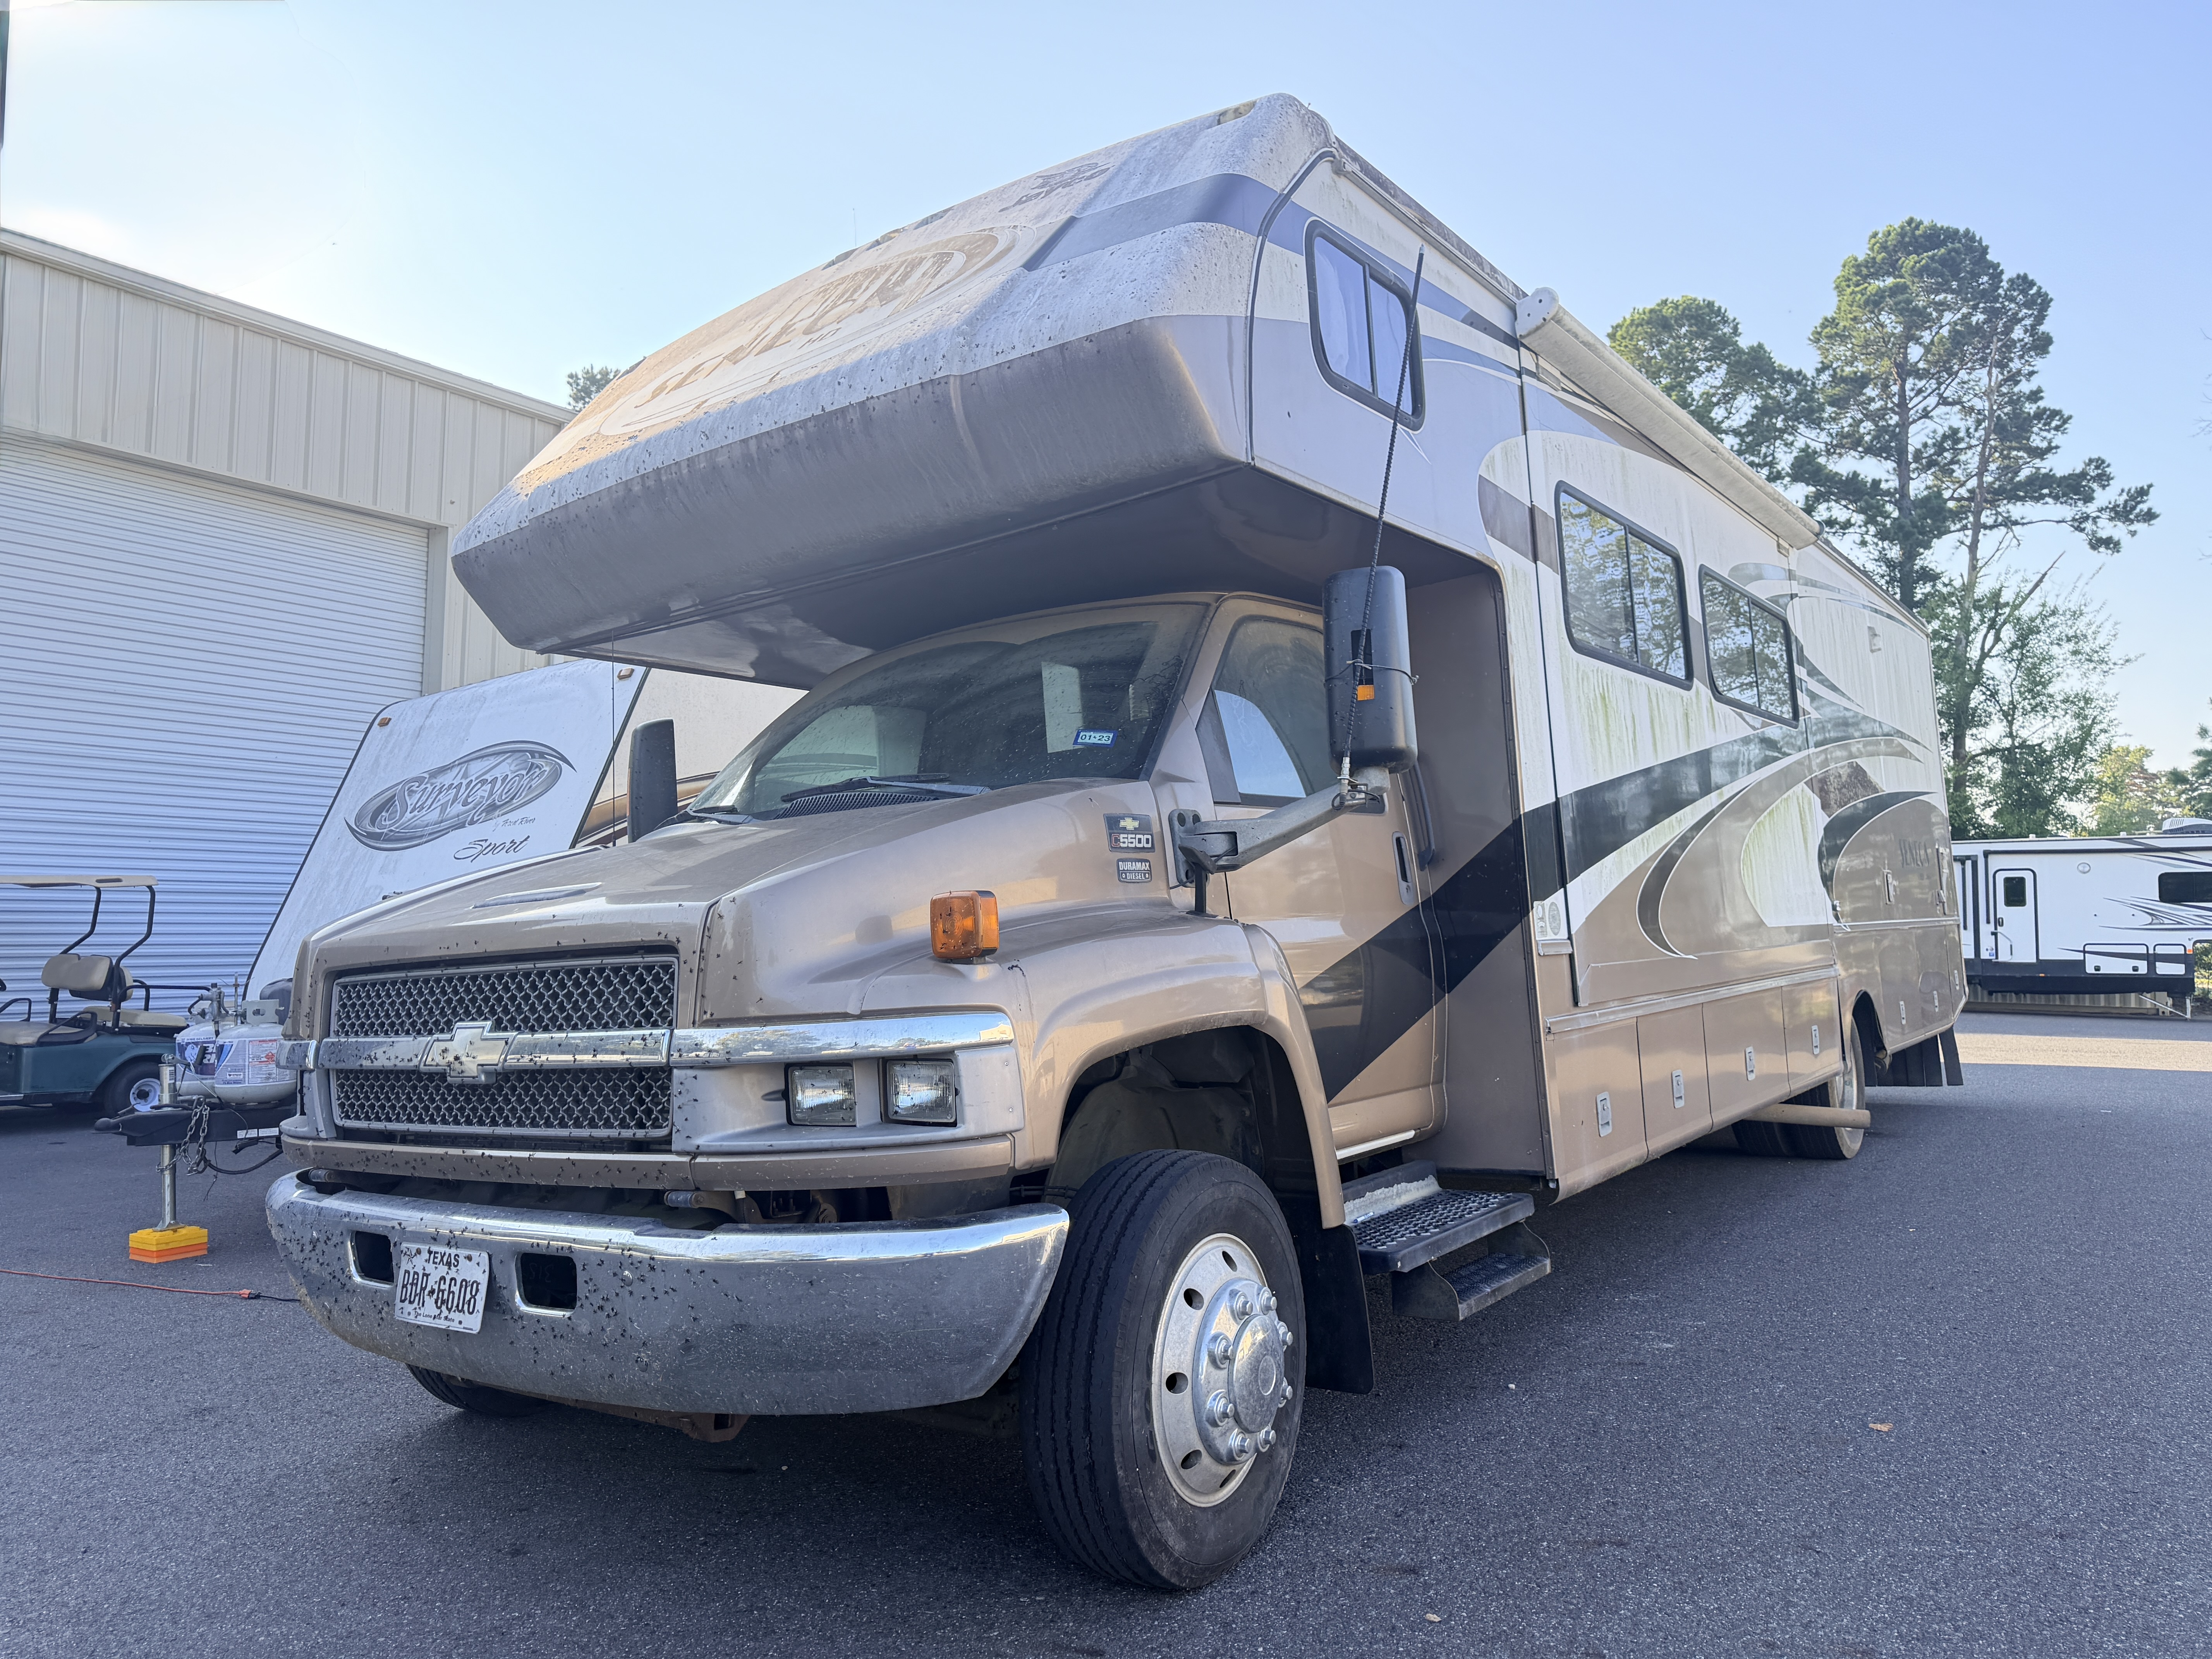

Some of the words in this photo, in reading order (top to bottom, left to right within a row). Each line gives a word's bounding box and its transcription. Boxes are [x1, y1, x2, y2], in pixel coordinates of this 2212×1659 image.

[798, 327, 842, 349] HD
[376, 769, 547, 830] Surveyor
[453, 835, 530, 863] Sport
[1111, 834, 1151, 847] C5500
[1119, 862, 1150, 871] DURAMAX
[428, 1250, 460, 1268] TEXAS
